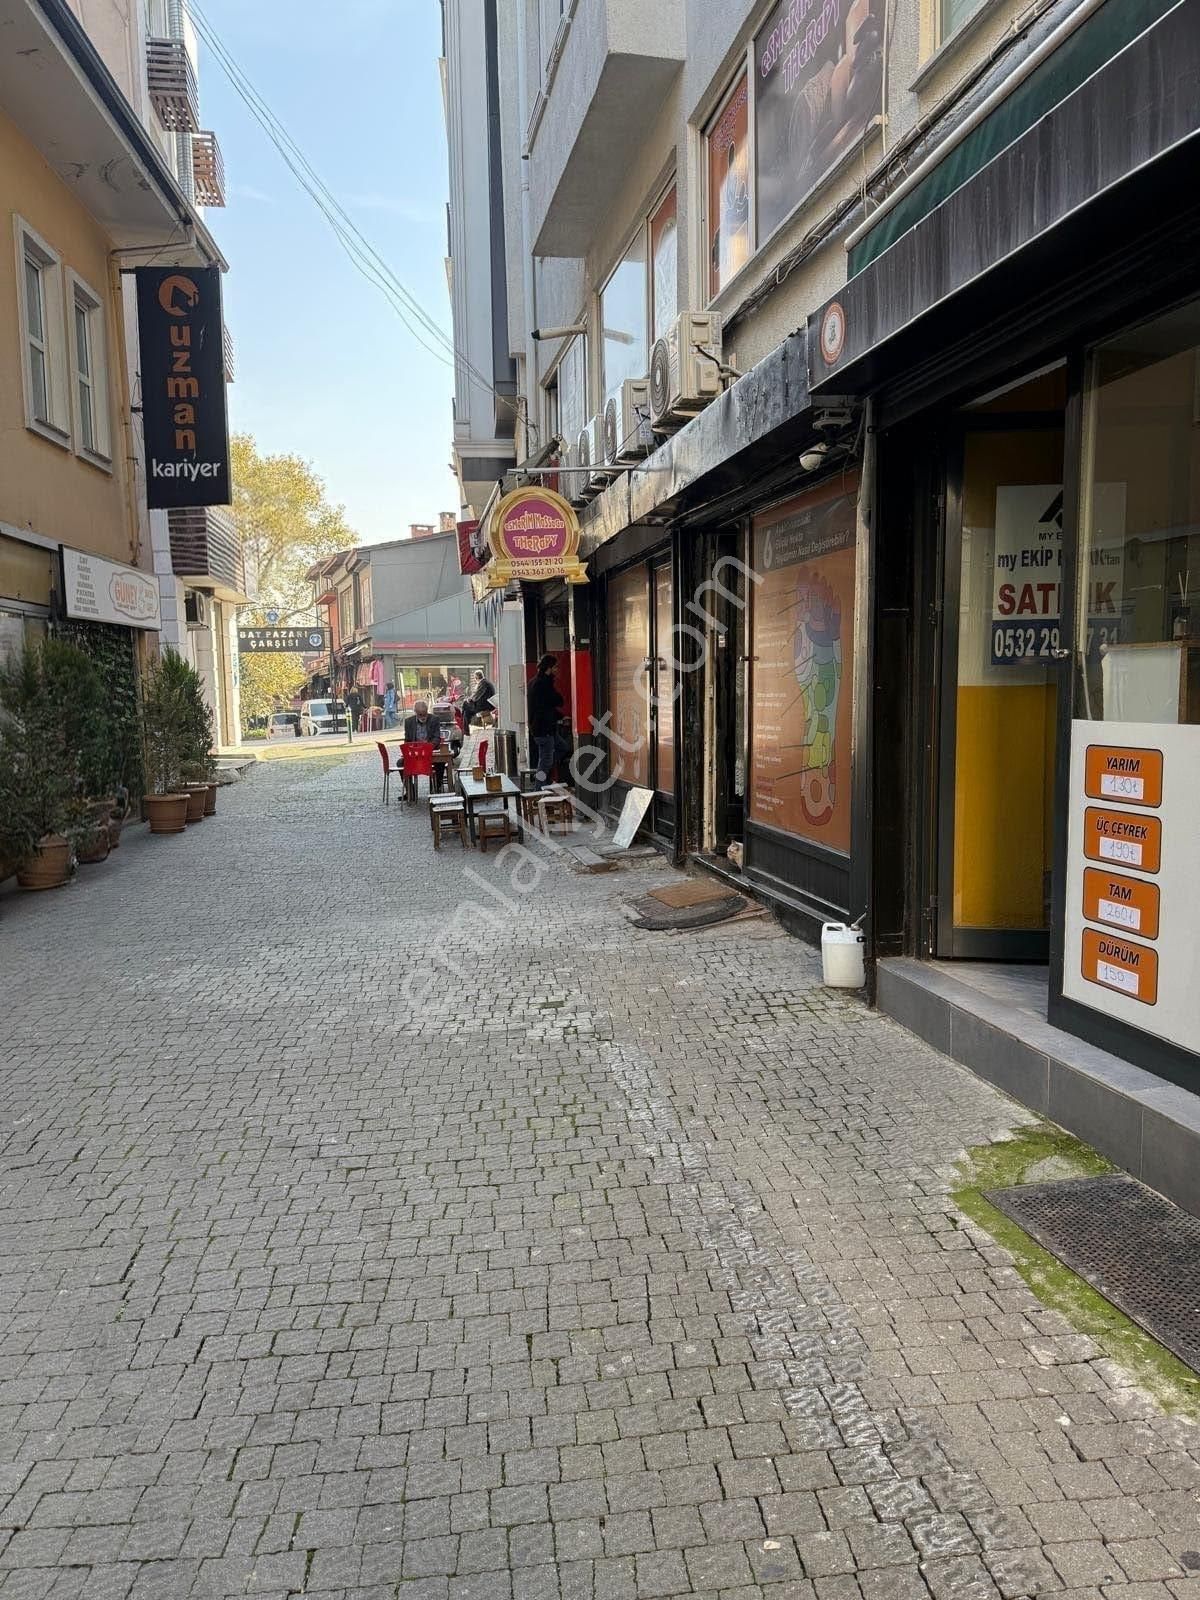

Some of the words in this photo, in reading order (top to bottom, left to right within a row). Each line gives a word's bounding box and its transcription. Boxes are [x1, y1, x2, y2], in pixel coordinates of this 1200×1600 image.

[167, 324, 200, 450] uzman
[151, 458, 221, 482] kariyer
[1038, 532, 1054, 541] MY
[997, 553, 1018, 571] my
[1021, 546, 1054, 567] EKİP
[994, 628, 1036, 658] 0532
[1106, 756, 1141, 773] YARIM
[1096, 816, 1110, 835] ÜÇ
[1111, 822, 1148, 839] ÇEYREK
[1109, 883, 1132, 901] TAM
[1099, 940, 1140, 966] DÜRÜM
